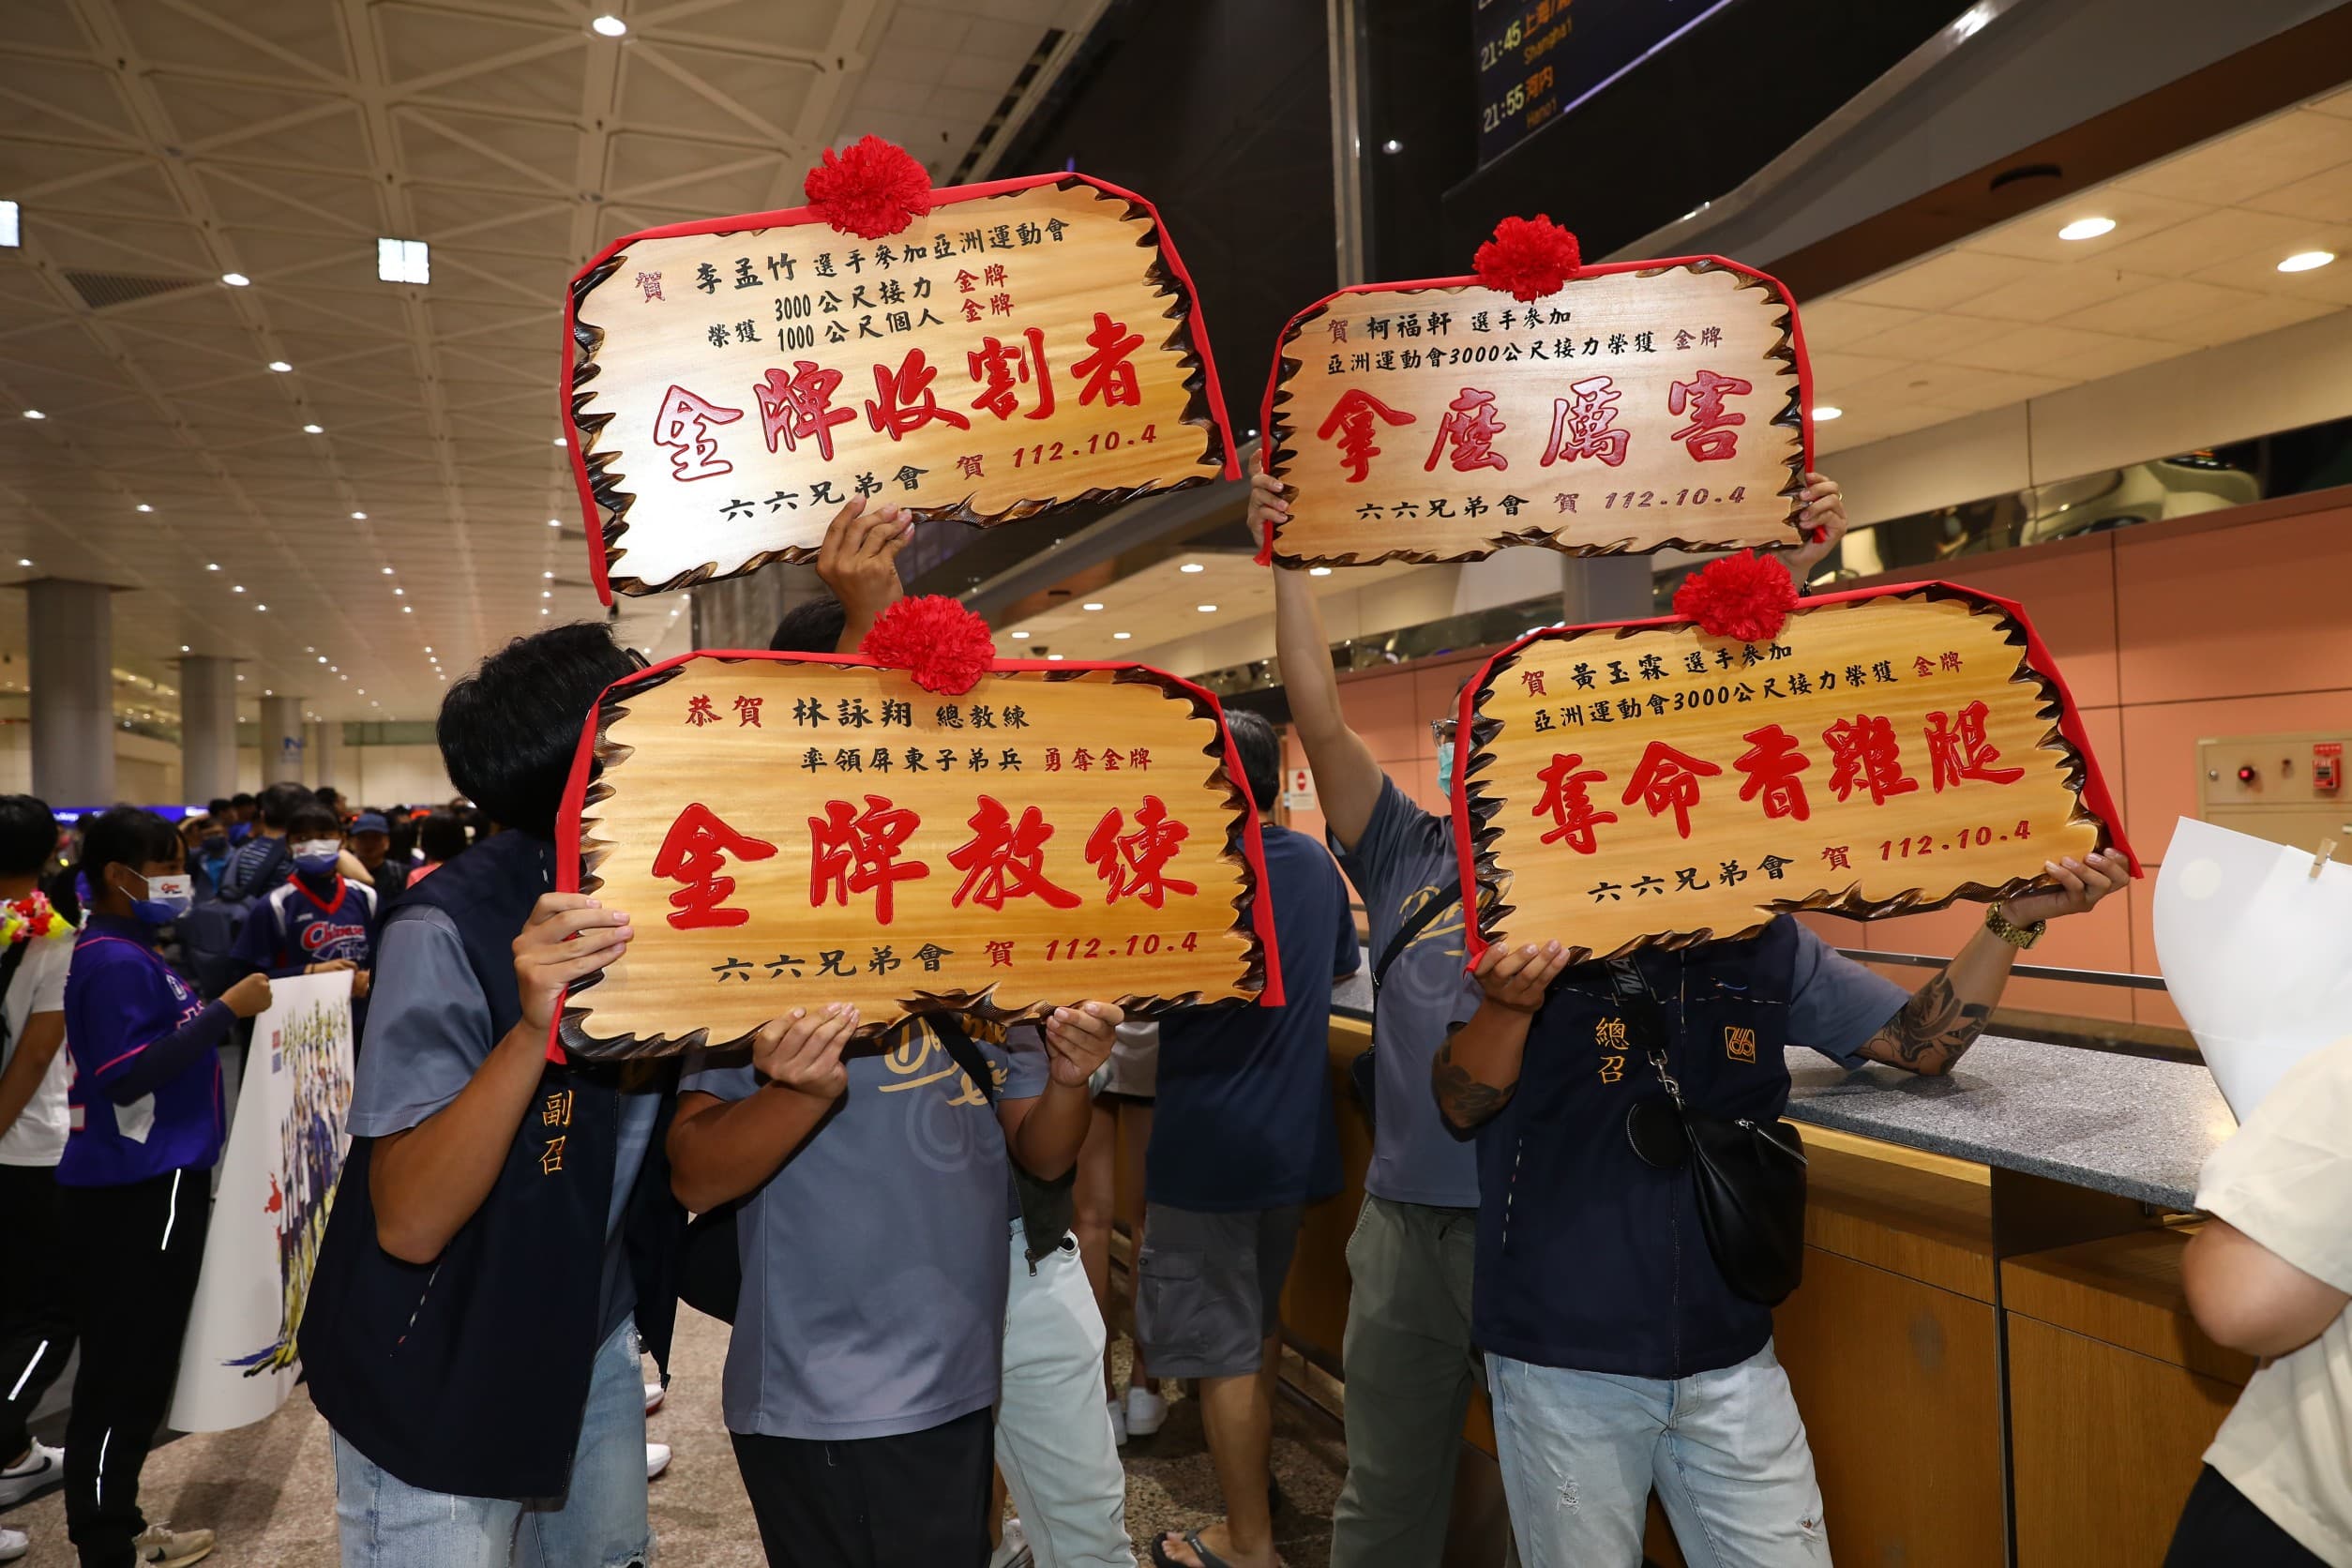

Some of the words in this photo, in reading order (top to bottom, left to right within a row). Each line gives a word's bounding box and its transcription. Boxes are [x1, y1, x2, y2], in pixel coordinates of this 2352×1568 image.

[1481, 20, 1521, 71] 21:45
[1484, 83, 1524, 132] 21:55
[635, 271, 666, 304] 賀
[697, 252, 797, 294] 李孟竹
[814, 218, 1069, 279] 選手參加亞洲運動會
[774, 276, 934, 322] 3000公尺接力
[955, 264, 1008, 294] 金牌
[708, 319, 761, 348] 榮獲
[776, 305, 943, 352] 1000公尺個人
[960, 294, 1015, 324] 金牌
[1327, 317, 1349, 344] 賀
[1366, 311, 1452, 340] 柯福軒
[1471, 307, 1571, 333] 選手參加
[1328, 329, 1656, 375] 亞洲運動會3000公尺接力榮獲
[1671, 325, 1725, 352] 金牌
[654, 312, 1147, 482] 金牌收割者
[719, 465, 928, 522] 六六兄弟會
[957, 454, 985, 479] 賀
[1014, 424, 1156, 468] 112.10.4
[1355, 494, 1530, 520] 六六兄弟會
[1554, 491, 1580, 514] 賀
[1604, 484, 1747, 511] 112.10.4
[1521, 671, 1546, 698] 賀
[1571, 654, 1669, 690] 黃玉霖
[1683, 641, 1792, 673] 選手參加
[1534, 656, 1899, 732] 亞洲運動會3000公尺接力榮獲
[1913, 651, 1963, 677] 金牌
[686, 694, 763, 728] 恭賀
[793, 697, 912, 729] 林詠翔
[936, 703, 1030, 730] 總教練
[801, 746, 1022, 774] 率領屏東子弟兵
[1046, 747, 1152, 772] 勇奪金牌
[1532, 701, 2026, 855] 奪命香雞腿
[651, 794, 1199, 931] 金牌教練
[1587, 854, 1796, 904] 六六兄弟會
[1822, 846, 1851, 871] 賀
[1880, 821, 2030, 862] 112.10.4
[711, 942, 955, 982] 六六兄弟會
[986, 941, 1015, 967] 賀
[1047, 931, 1198, 961] 112.10.4
[1595, 1017, 1630, 1084] 總召
[539, 1090, 574, 1175] 副召
